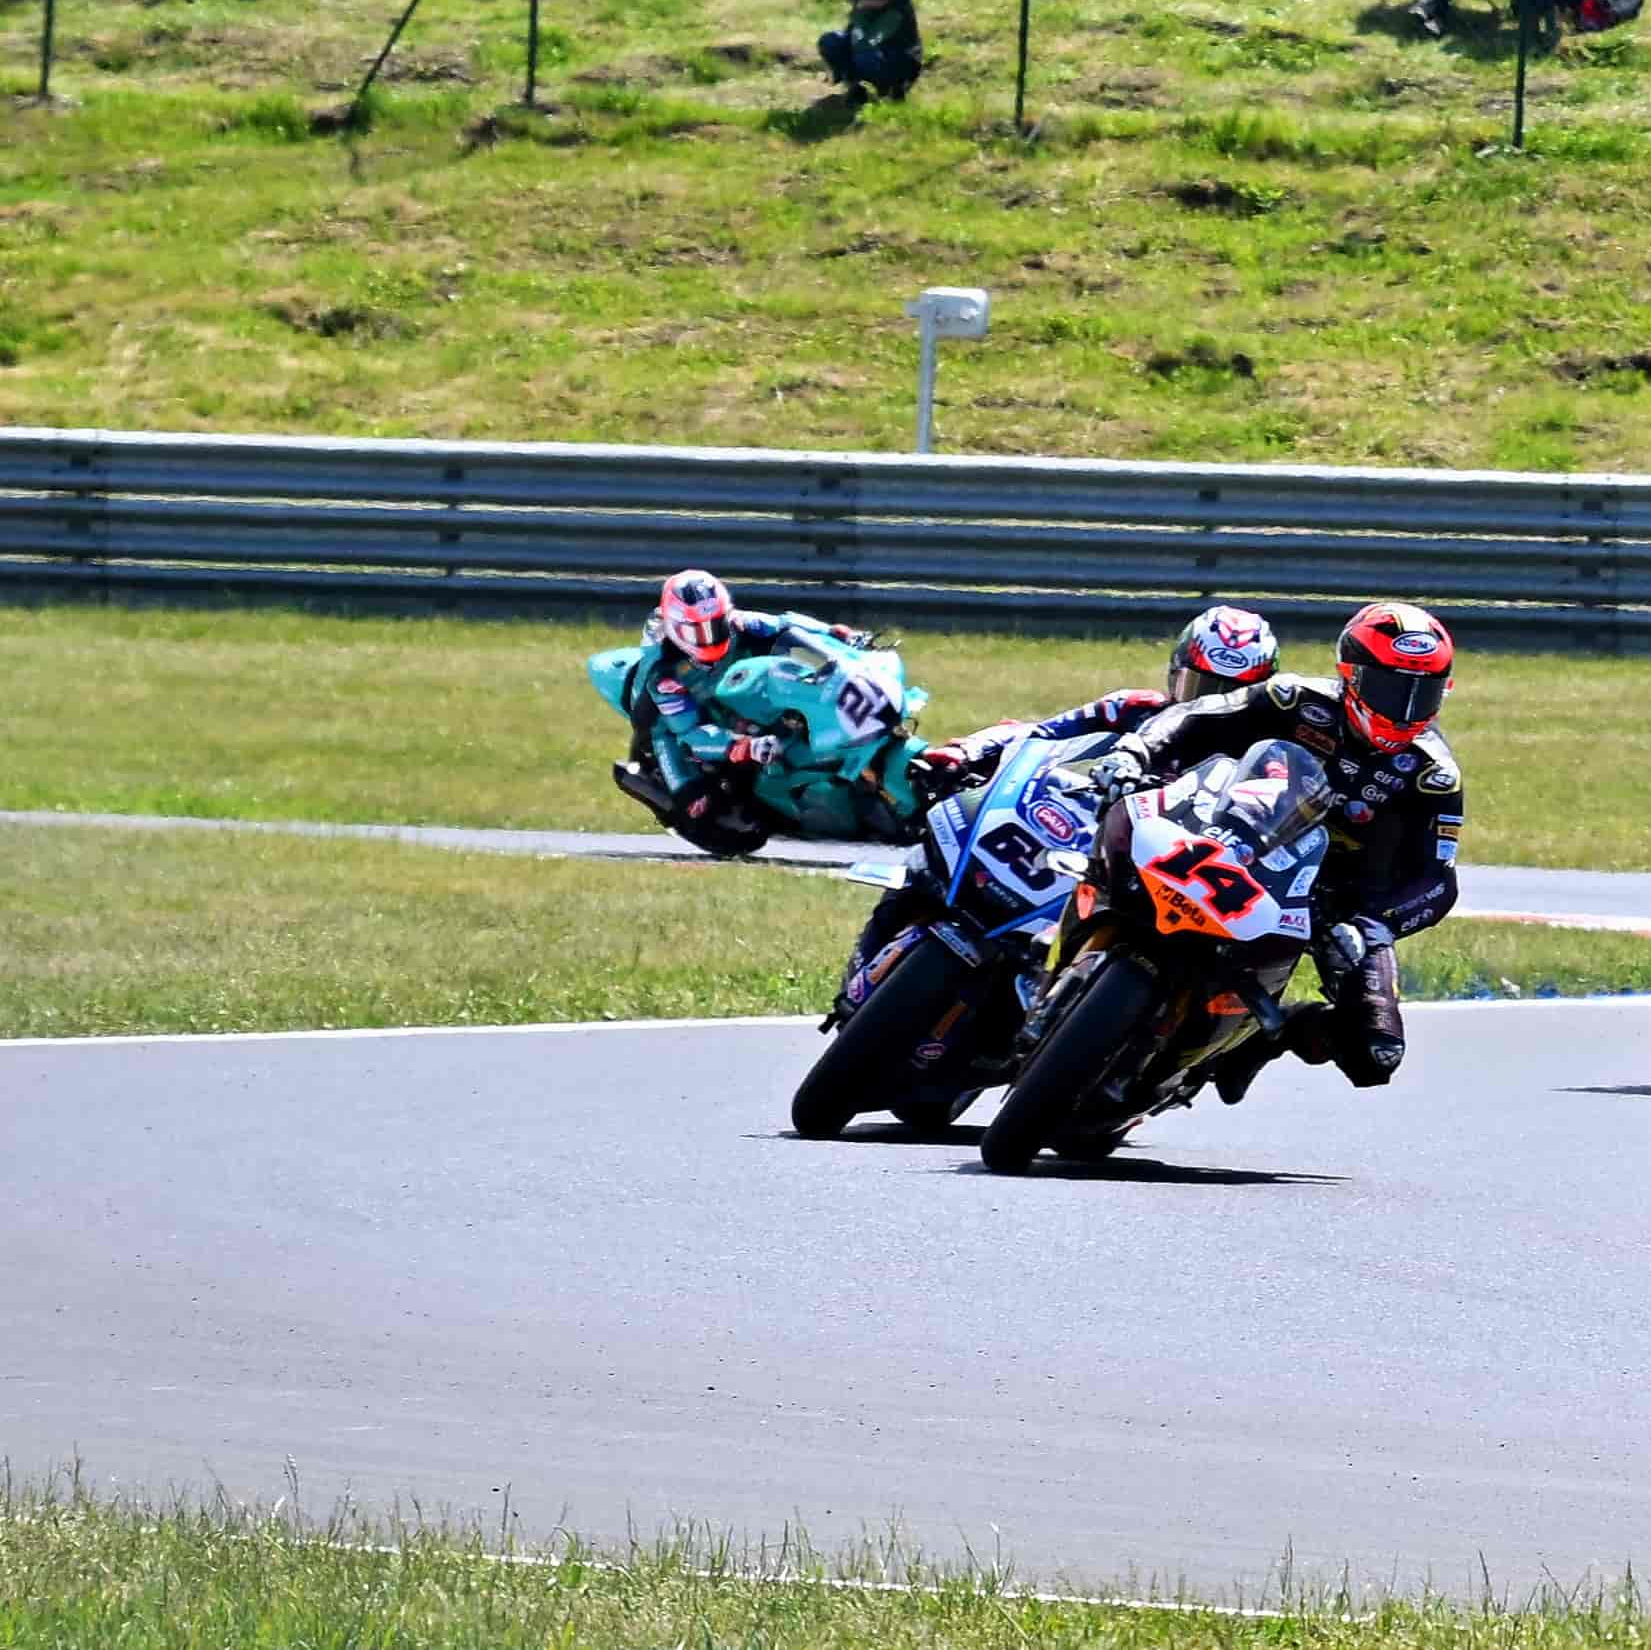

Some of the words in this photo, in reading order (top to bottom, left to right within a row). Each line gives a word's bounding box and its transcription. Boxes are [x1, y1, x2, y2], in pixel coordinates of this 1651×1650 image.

[1211, 649, 1247, 666] Arai
[1202, 825, 1243, 849] elf
[1146, 838, 1266, 923] 14
